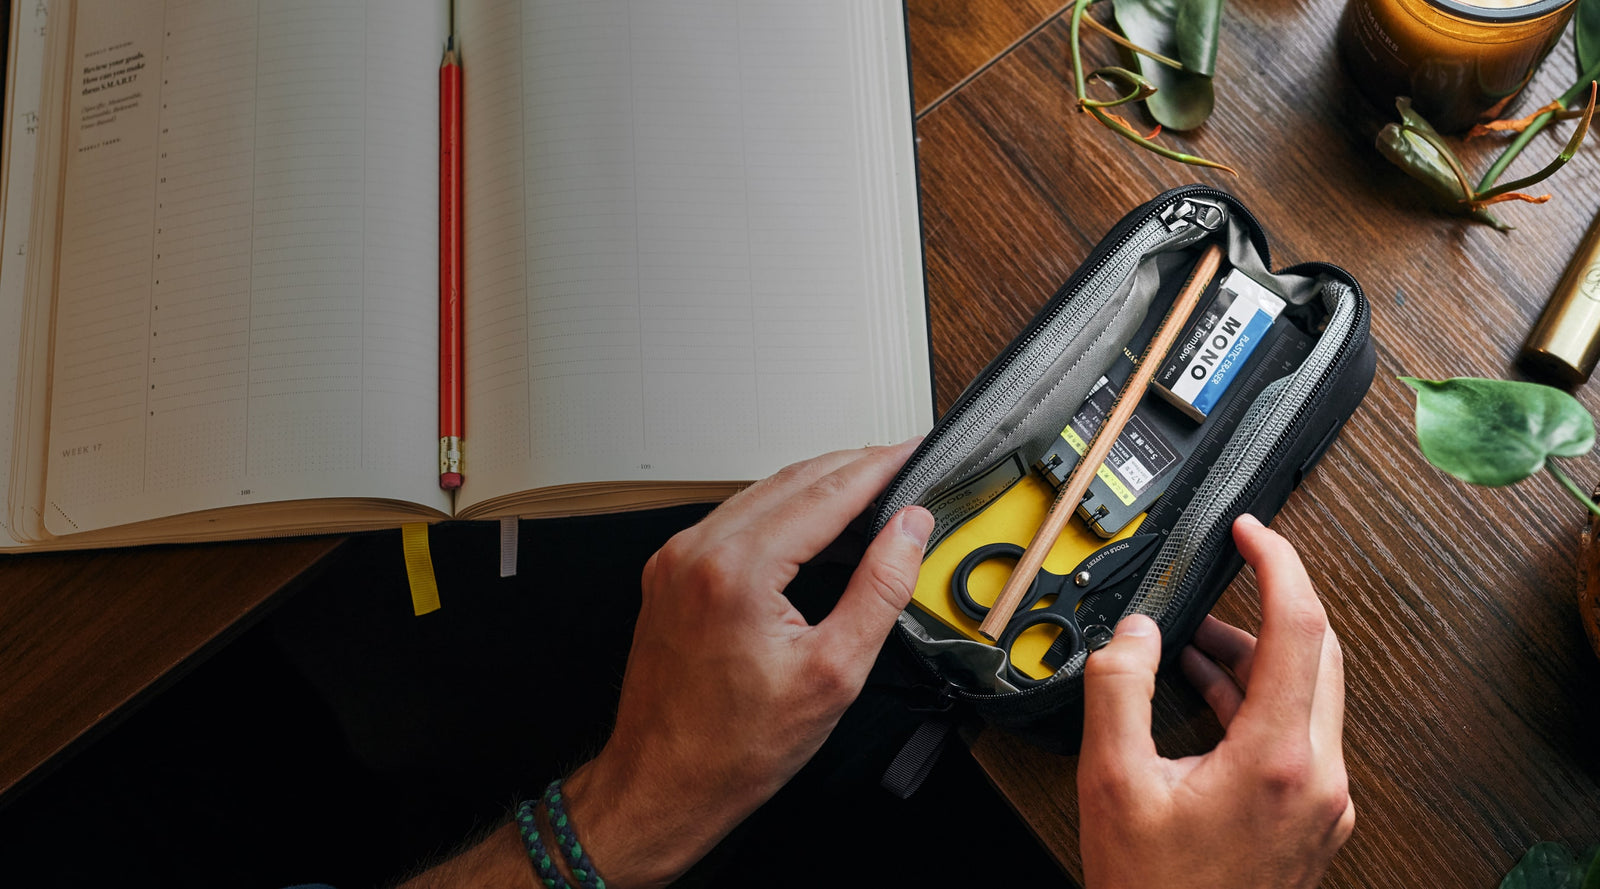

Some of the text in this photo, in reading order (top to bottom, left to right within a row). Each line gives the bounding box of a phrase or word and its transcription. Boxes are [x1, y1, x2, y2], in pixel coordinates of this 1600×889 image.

[83, 63, 107, 75] Review
[108, 59, 124, 70] your
[83, 63, 146, 86] How can you make
[82, 86, 100, 96] them
[1179, 328, 1207, 362] Tombow
[1191, 316, 1242, 380] MONO
[1211, 334, 1250, 385] PLASTIC ERASER
[1281, 360, 1293, 371] 14
[62, 443, 102, 458] WEEK 17
[941, 522, 949, 530] IN
[1161, 528, 1169, 536] 6
[1109, 542, 1130, 556] TOOLS
[1114, 592, 1123, 601] 3
[1098, 614, 1107, 622] 2
